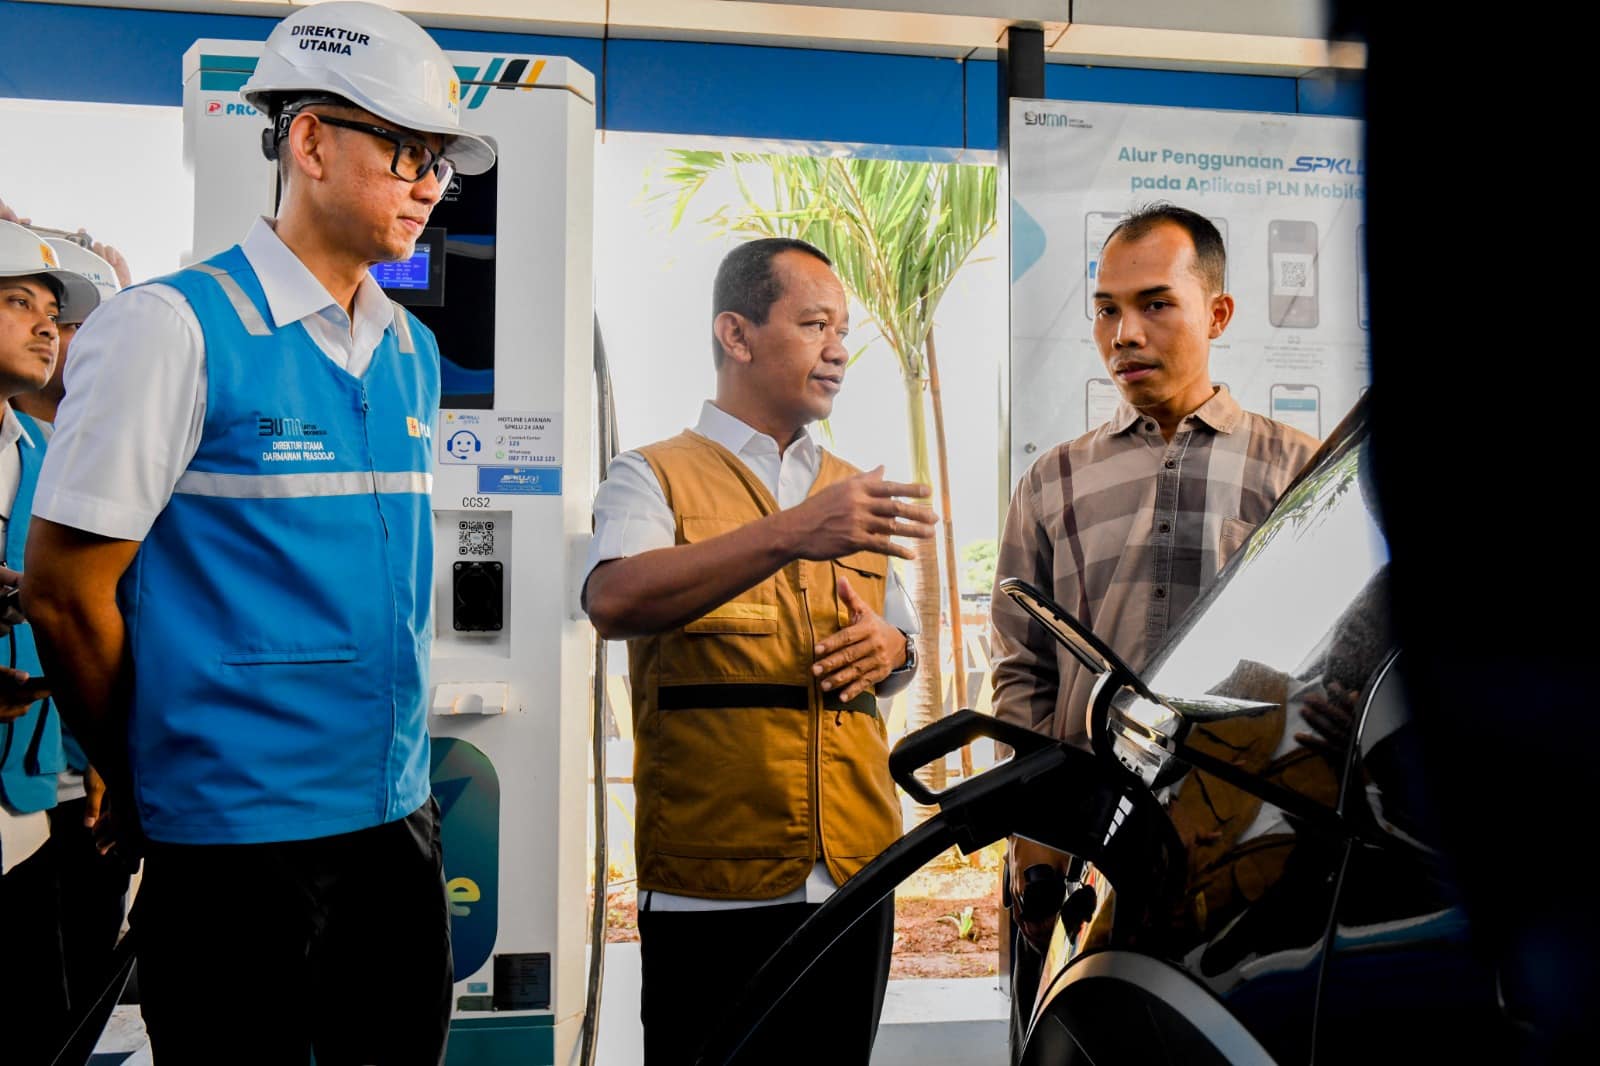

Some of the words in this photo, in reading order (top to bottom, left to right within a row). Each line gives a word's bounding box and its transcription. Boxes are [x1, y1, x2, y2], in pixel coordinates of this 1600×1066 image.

[291, 25, 370, 46] DIREKTUR
[299, 38, 352, 56] UTAMA
[226, 103, 261, 116] PRO
[1118, 146, 1158, 163] Alur
[1162, 148, 1284, 170] Penggunaan
[1131, 176, 1181, 193] pada
[1186, 176, 1262, 196] Aplikasi
[1266, 182, 1299, 196] PLN
[272, 441, 303, 450] DIREKTUR
[303, 441, 324, 450] UTAMA
[462, 496, 491, 508] CCS2
